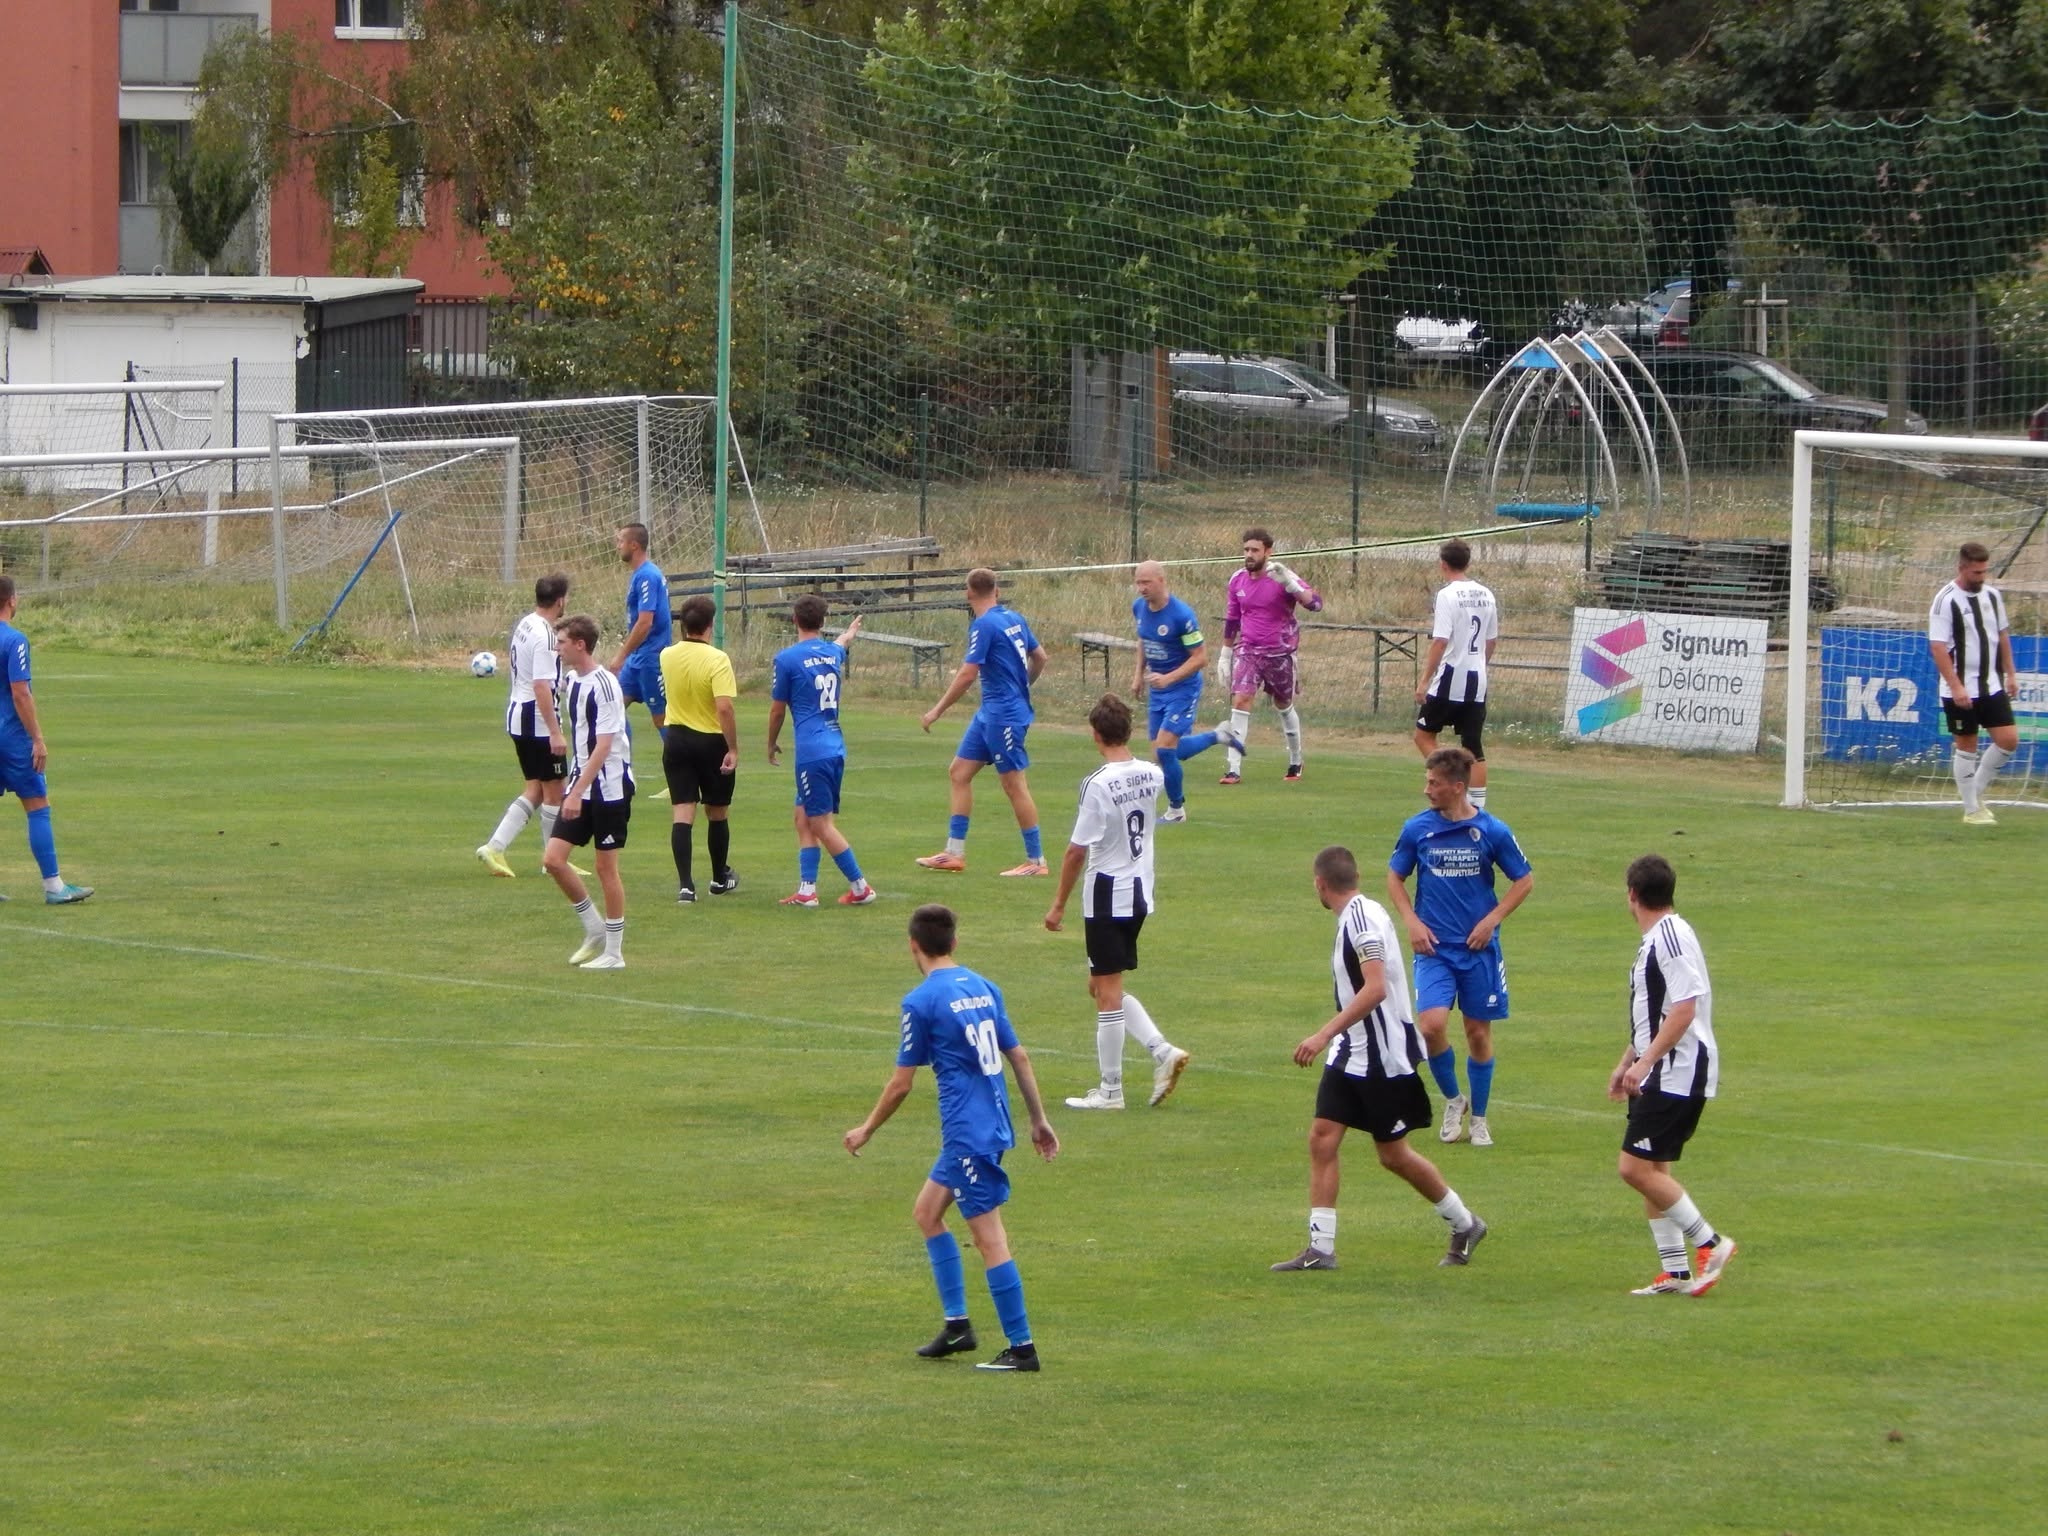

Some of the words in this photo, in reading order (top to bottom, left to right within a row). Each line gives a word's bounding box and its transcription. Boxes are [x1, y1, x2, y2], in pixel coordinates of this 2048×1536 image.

[1468, 615, 1481, 655] 2
[1662, 628, 1748, 661] Signum
[814, 672, 838, 711] 22
[1658, 667, 1743, 694] Děláme
[1846, 676, 1920, 723] K2
[1655, 699, 1744, 726] reklamu
[1108, 780, 1122, 792] FC
[1127, 772, 1154, 788] SIGMA
[1126, 809, 1145, 862] 8
[965, 1019, 1003, 1076] 20
